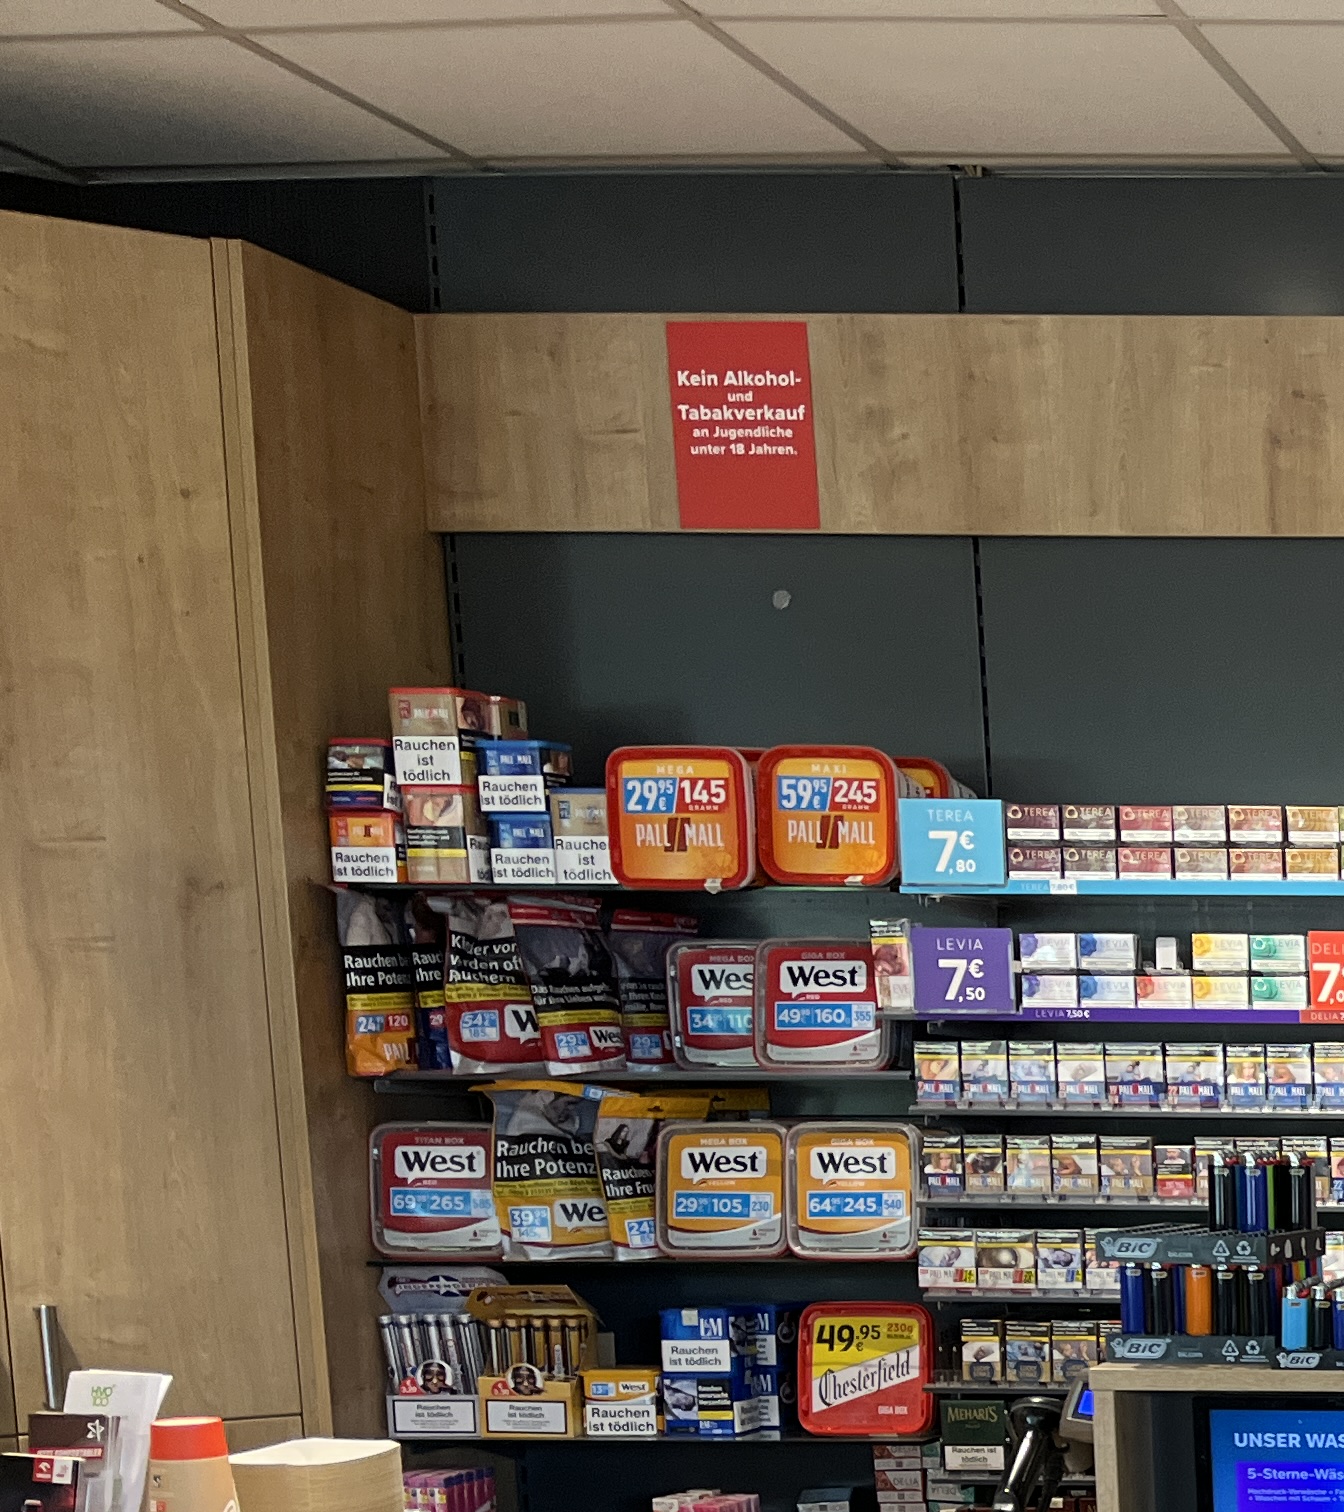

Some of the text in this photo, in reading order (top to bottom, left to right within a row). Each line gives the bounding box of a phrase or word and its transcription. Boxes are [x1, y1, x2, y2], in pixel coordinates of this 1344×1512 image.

[677, 370, 802, 386] Kein Alkohol-
[728, 391, 753, 402] und
[677, 404, 805, 421] Tabakverkauf
[693, 426, 793, 440] an Jugendliche
[691, 444, 797, 455] unter 18 Jahren.
[394, 738, 455, 751] Rauchen
[417, 755, 434, 766] ist
[403, 769, 450, 782] tödlich
[680, 780, 725, 804] 145
[834, 781, 876, 803] 245
[928, 810, 973, 822] TEREA
[635, 823, 724, 847] PALL MALL
[788, 820, 874, 845] PALL MALL
[937, 938, 983, 950] LEVIA
[787, 966, 858, 987] West
[497, 1138, 567, 1156] Rauchen
[401, 1151, 477, 1173] West
[496, 1158, 596, 1178] Ihre Potenz
[688, 1151, 758, 1173] West
[817, 1152, 887, 1174] West
[819, 1350, 910, 1407] Chesterfield
[592, 1408, 650, 1418] Rauchen
[947, 1406, 998, 1423] MEHARI'S
[589, 1419, 655, 1432] ist tödlich
[1233, 1432, 1301, 1449] UNSER
